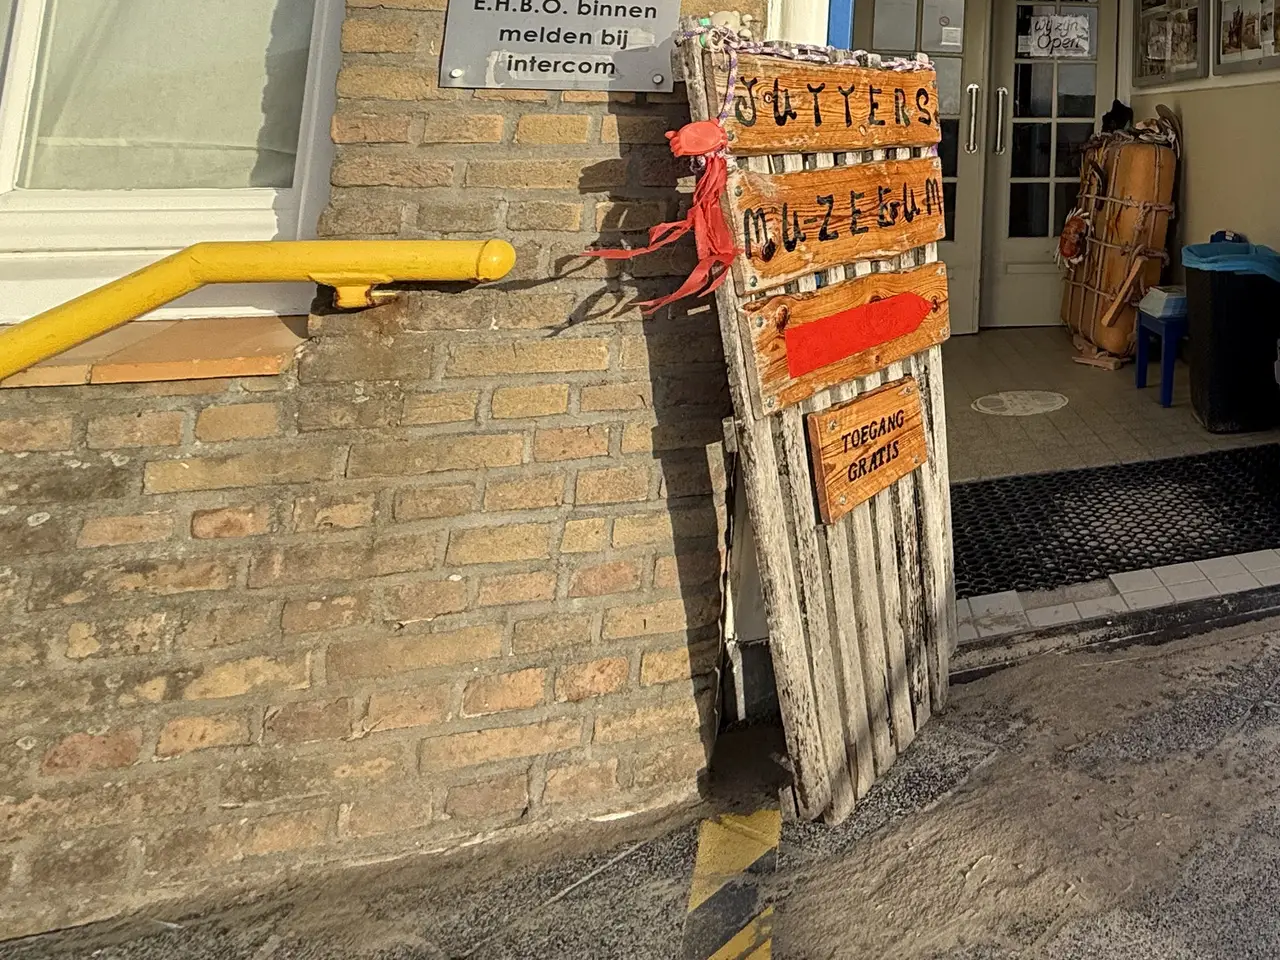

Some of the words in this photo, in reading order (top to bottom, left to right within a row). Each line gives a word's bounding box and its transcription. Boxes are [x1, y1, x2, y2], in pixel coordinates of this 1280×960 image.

[577, 0, 657, 19] binnen
[499, 26, 592, 44] melden
[600, 29, 629, 50] bij
[1038, 33, 1079, 54] Open
[506, 54, 616, 75] intercom
[735, 76, 932, 127] JUTTERS
[841, 409, 905, 453] TOEGANG
[848, 440, 899, 482] GRATIS
